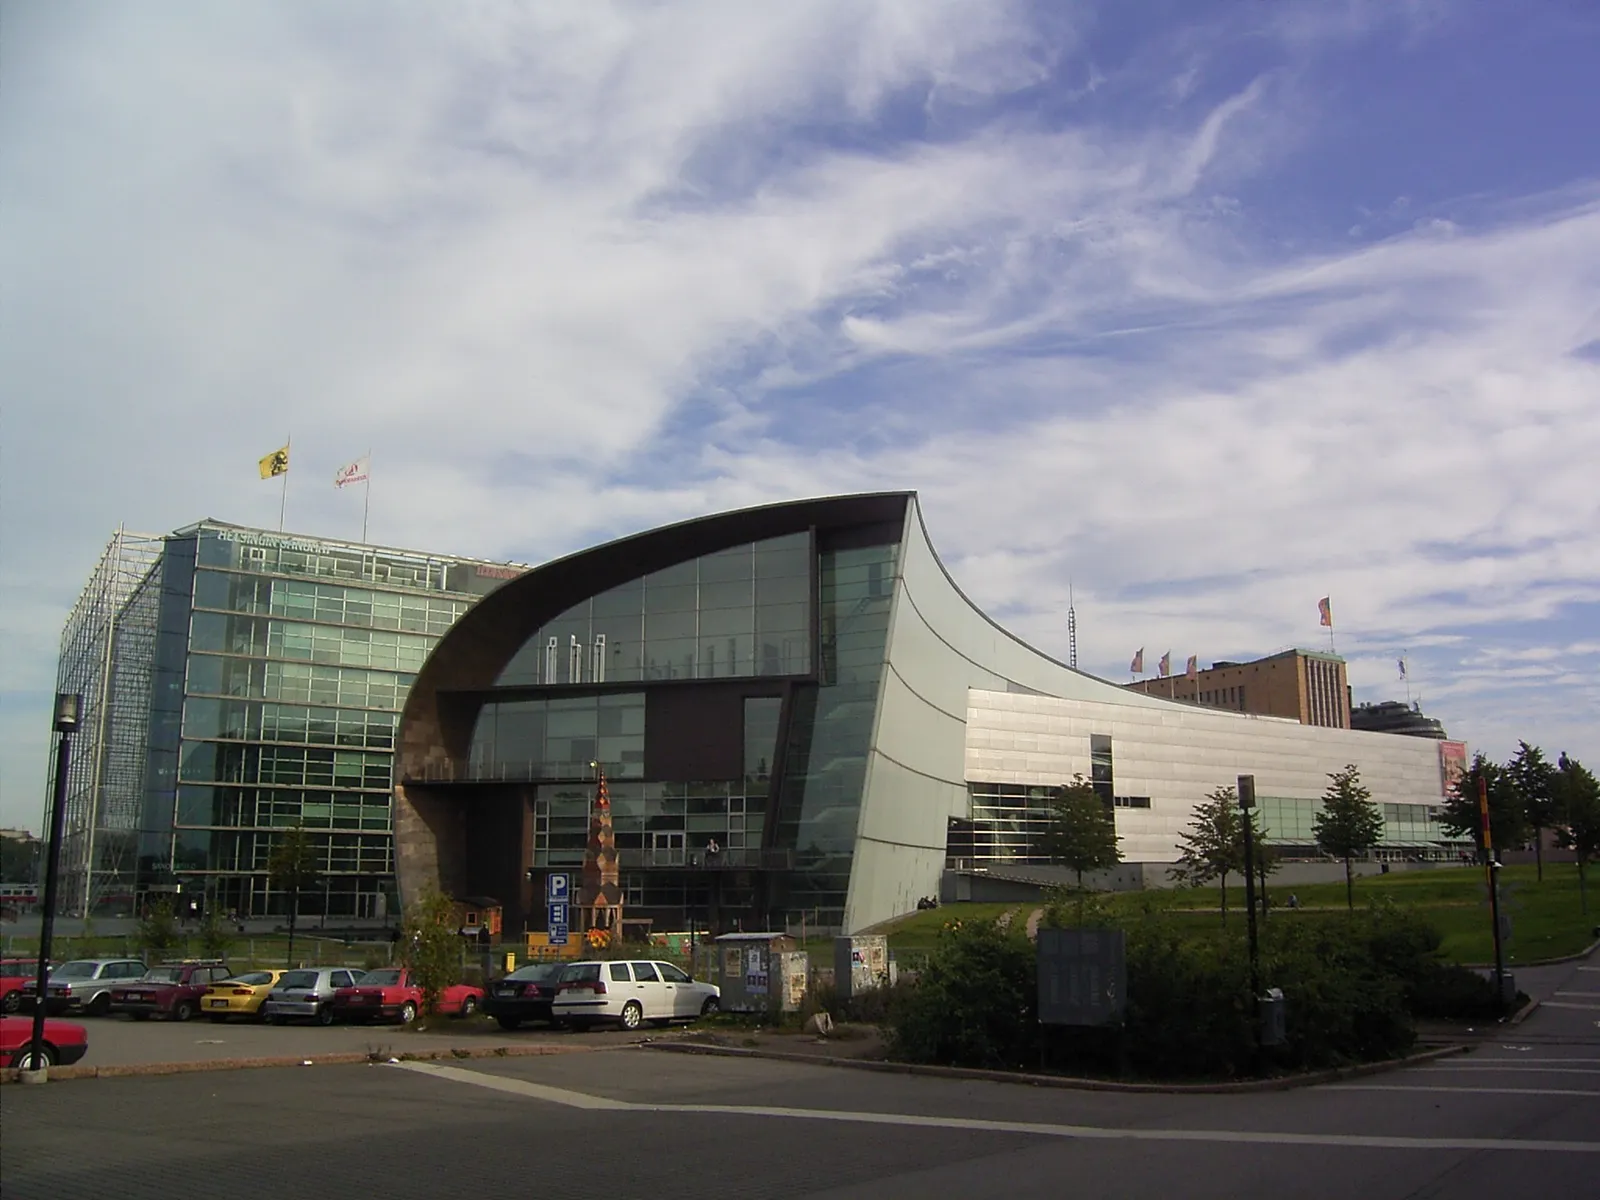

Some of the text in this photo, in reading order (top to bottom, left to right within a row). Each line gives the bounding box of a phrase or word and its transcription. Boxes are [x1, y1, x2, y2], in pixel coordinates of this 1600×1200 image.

[217, 530, 331, 555] HELSINGIN SANOMAT
[551, 876, 566, 896] P
